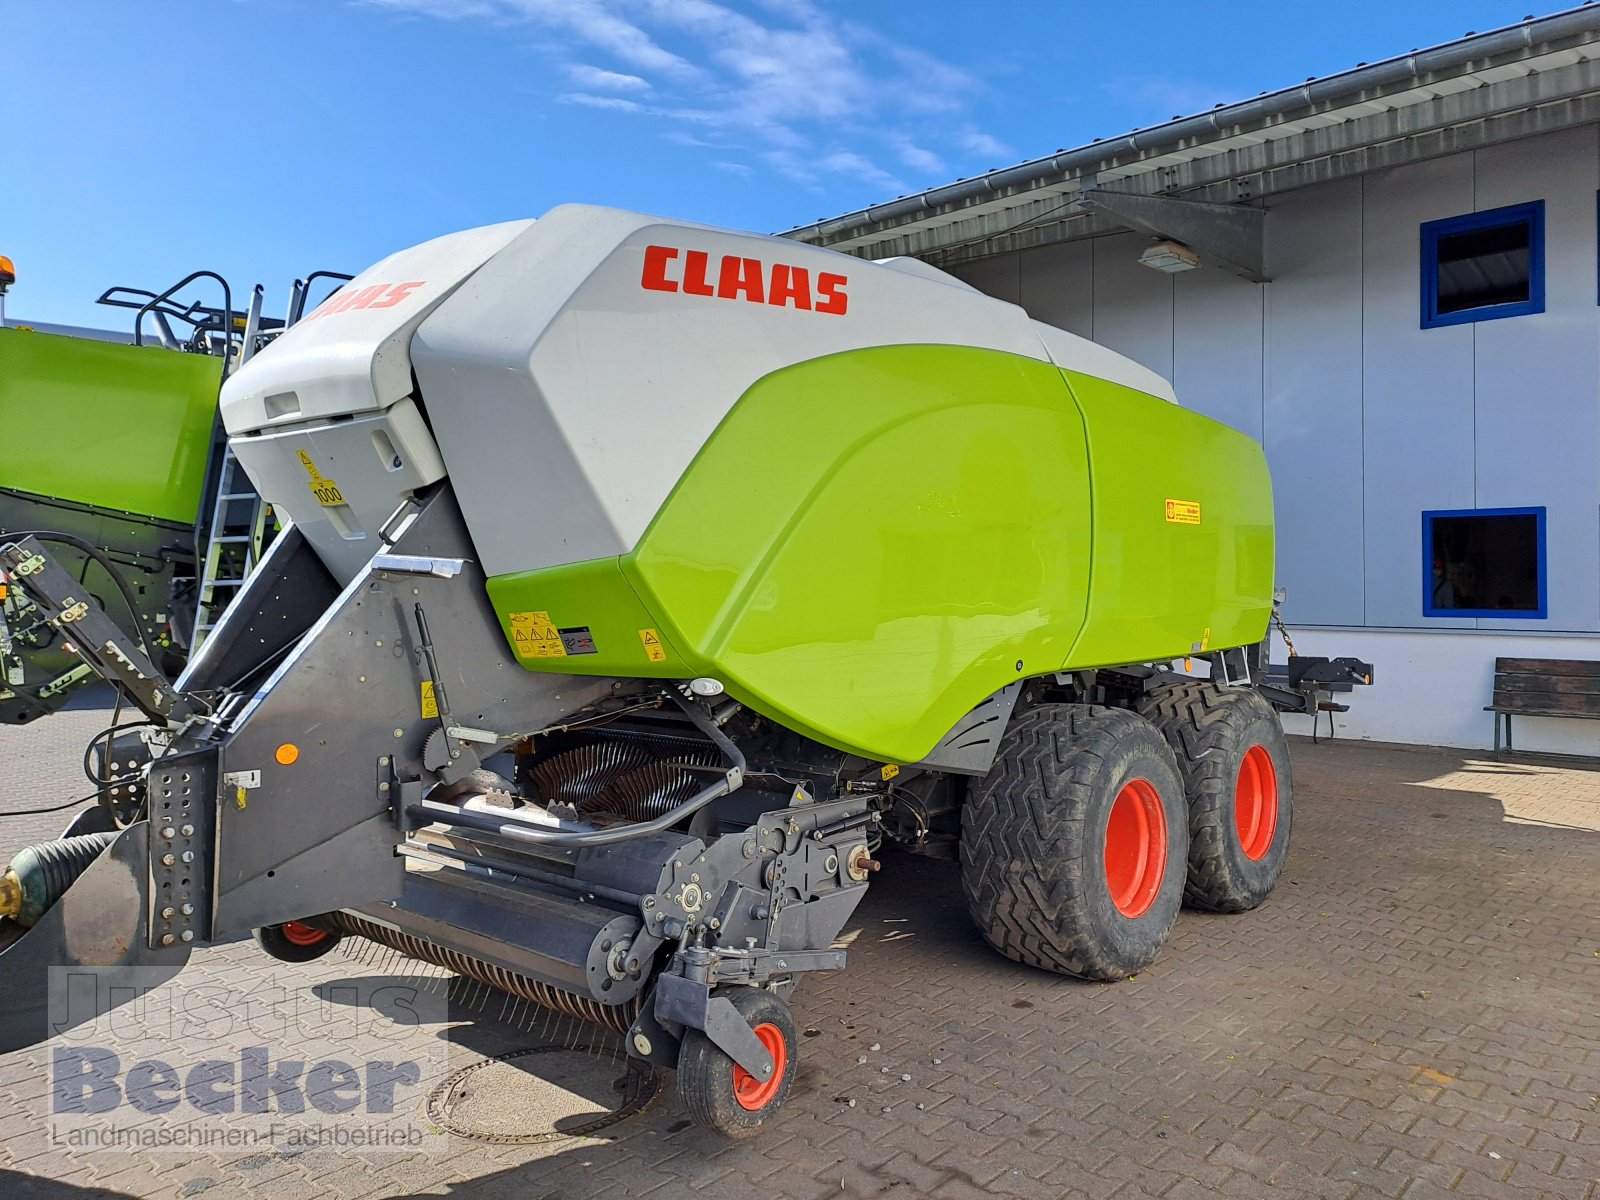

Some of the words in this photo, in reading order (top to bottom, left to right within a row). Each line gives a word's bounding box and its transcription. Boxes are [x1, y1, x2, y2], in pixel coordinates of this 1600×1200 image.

[641, 245, 848, 316] CLAAS
[301, 281, 426, 322] AAS
[314, 487, 342, 503] 1000
